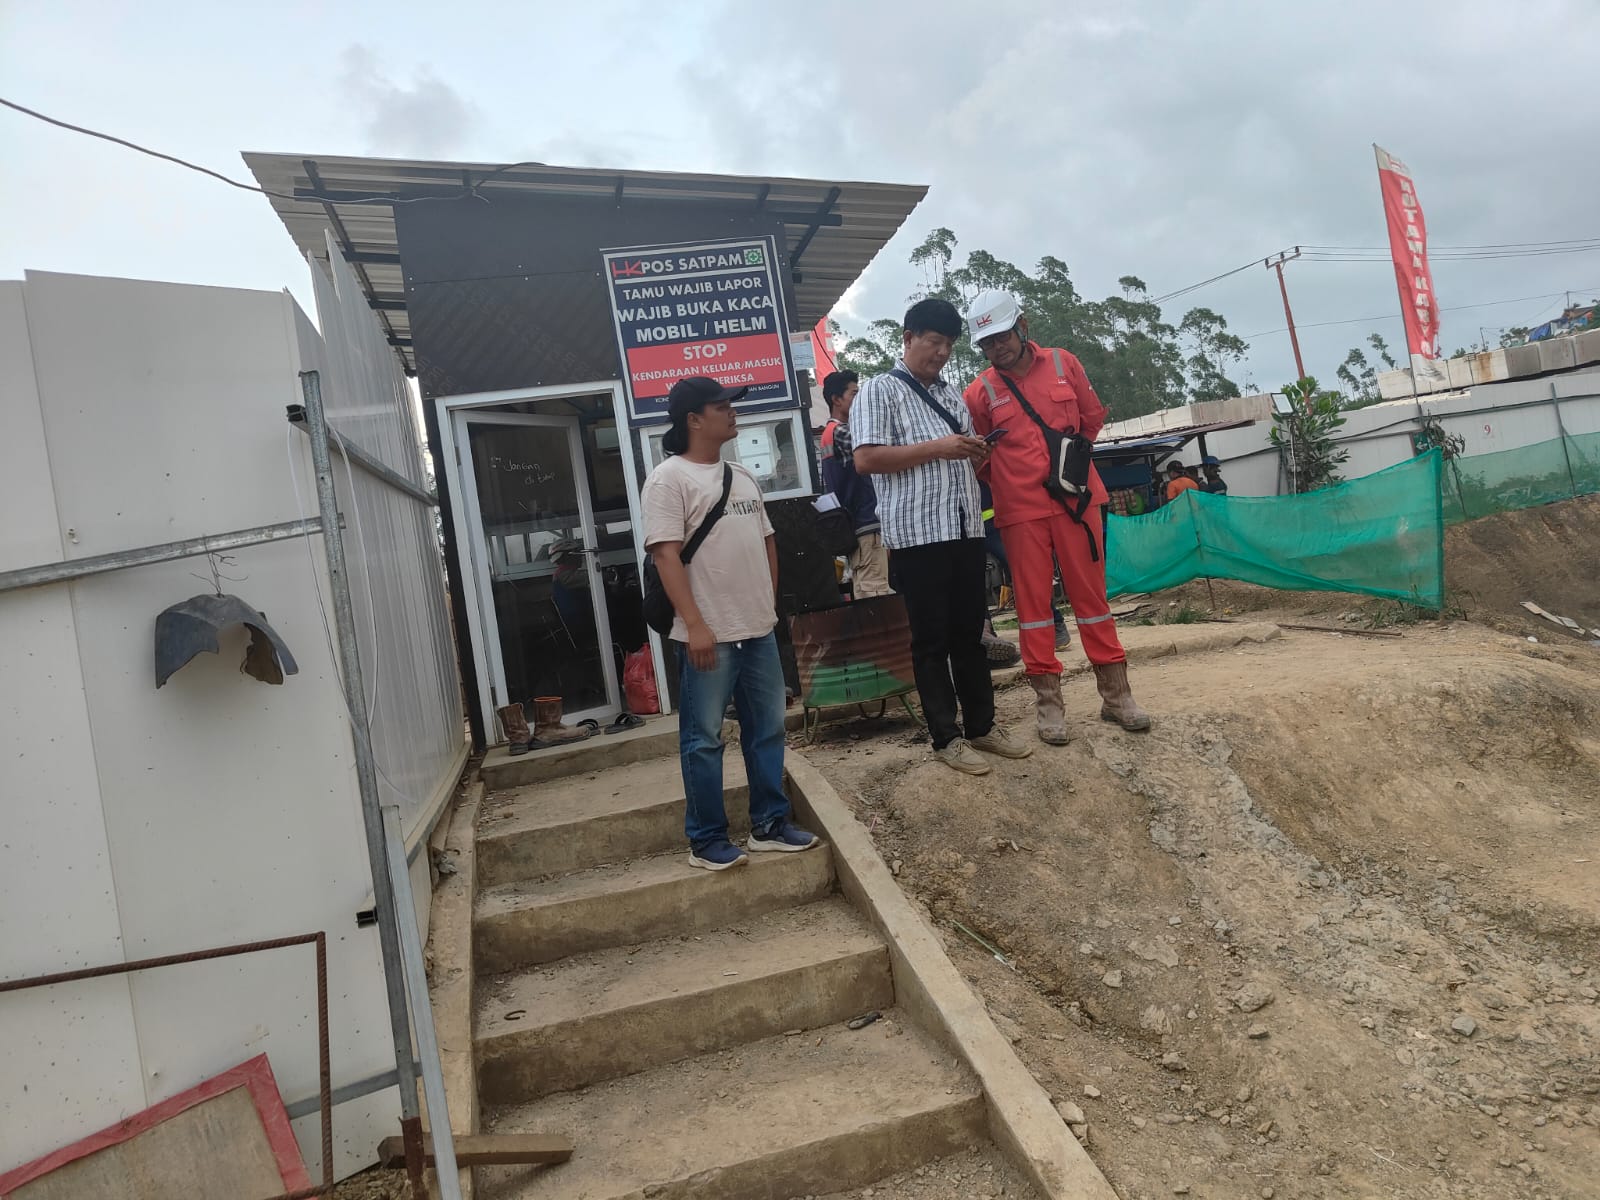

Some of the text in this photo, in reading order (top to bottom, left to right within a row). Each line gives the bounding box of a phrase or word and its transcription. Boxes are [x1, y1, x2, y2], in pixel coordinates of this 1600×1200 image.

[641, 259, 675, 274] POS
[678, 253, 743, 271] SATPAM
[623, 277, 763, 301] TAMU WAJIB LAPOR
[617, 295, 774, 323] WAJIB BUKA KACA
[635, 323, 699, 343] MOBIL
[713, 315, 767, 334] HELM
[682, 343, 728, 360] STOP
[632, 366, 700, 382] KENDARAAN
[1484, 424, 1491, 435] 9
